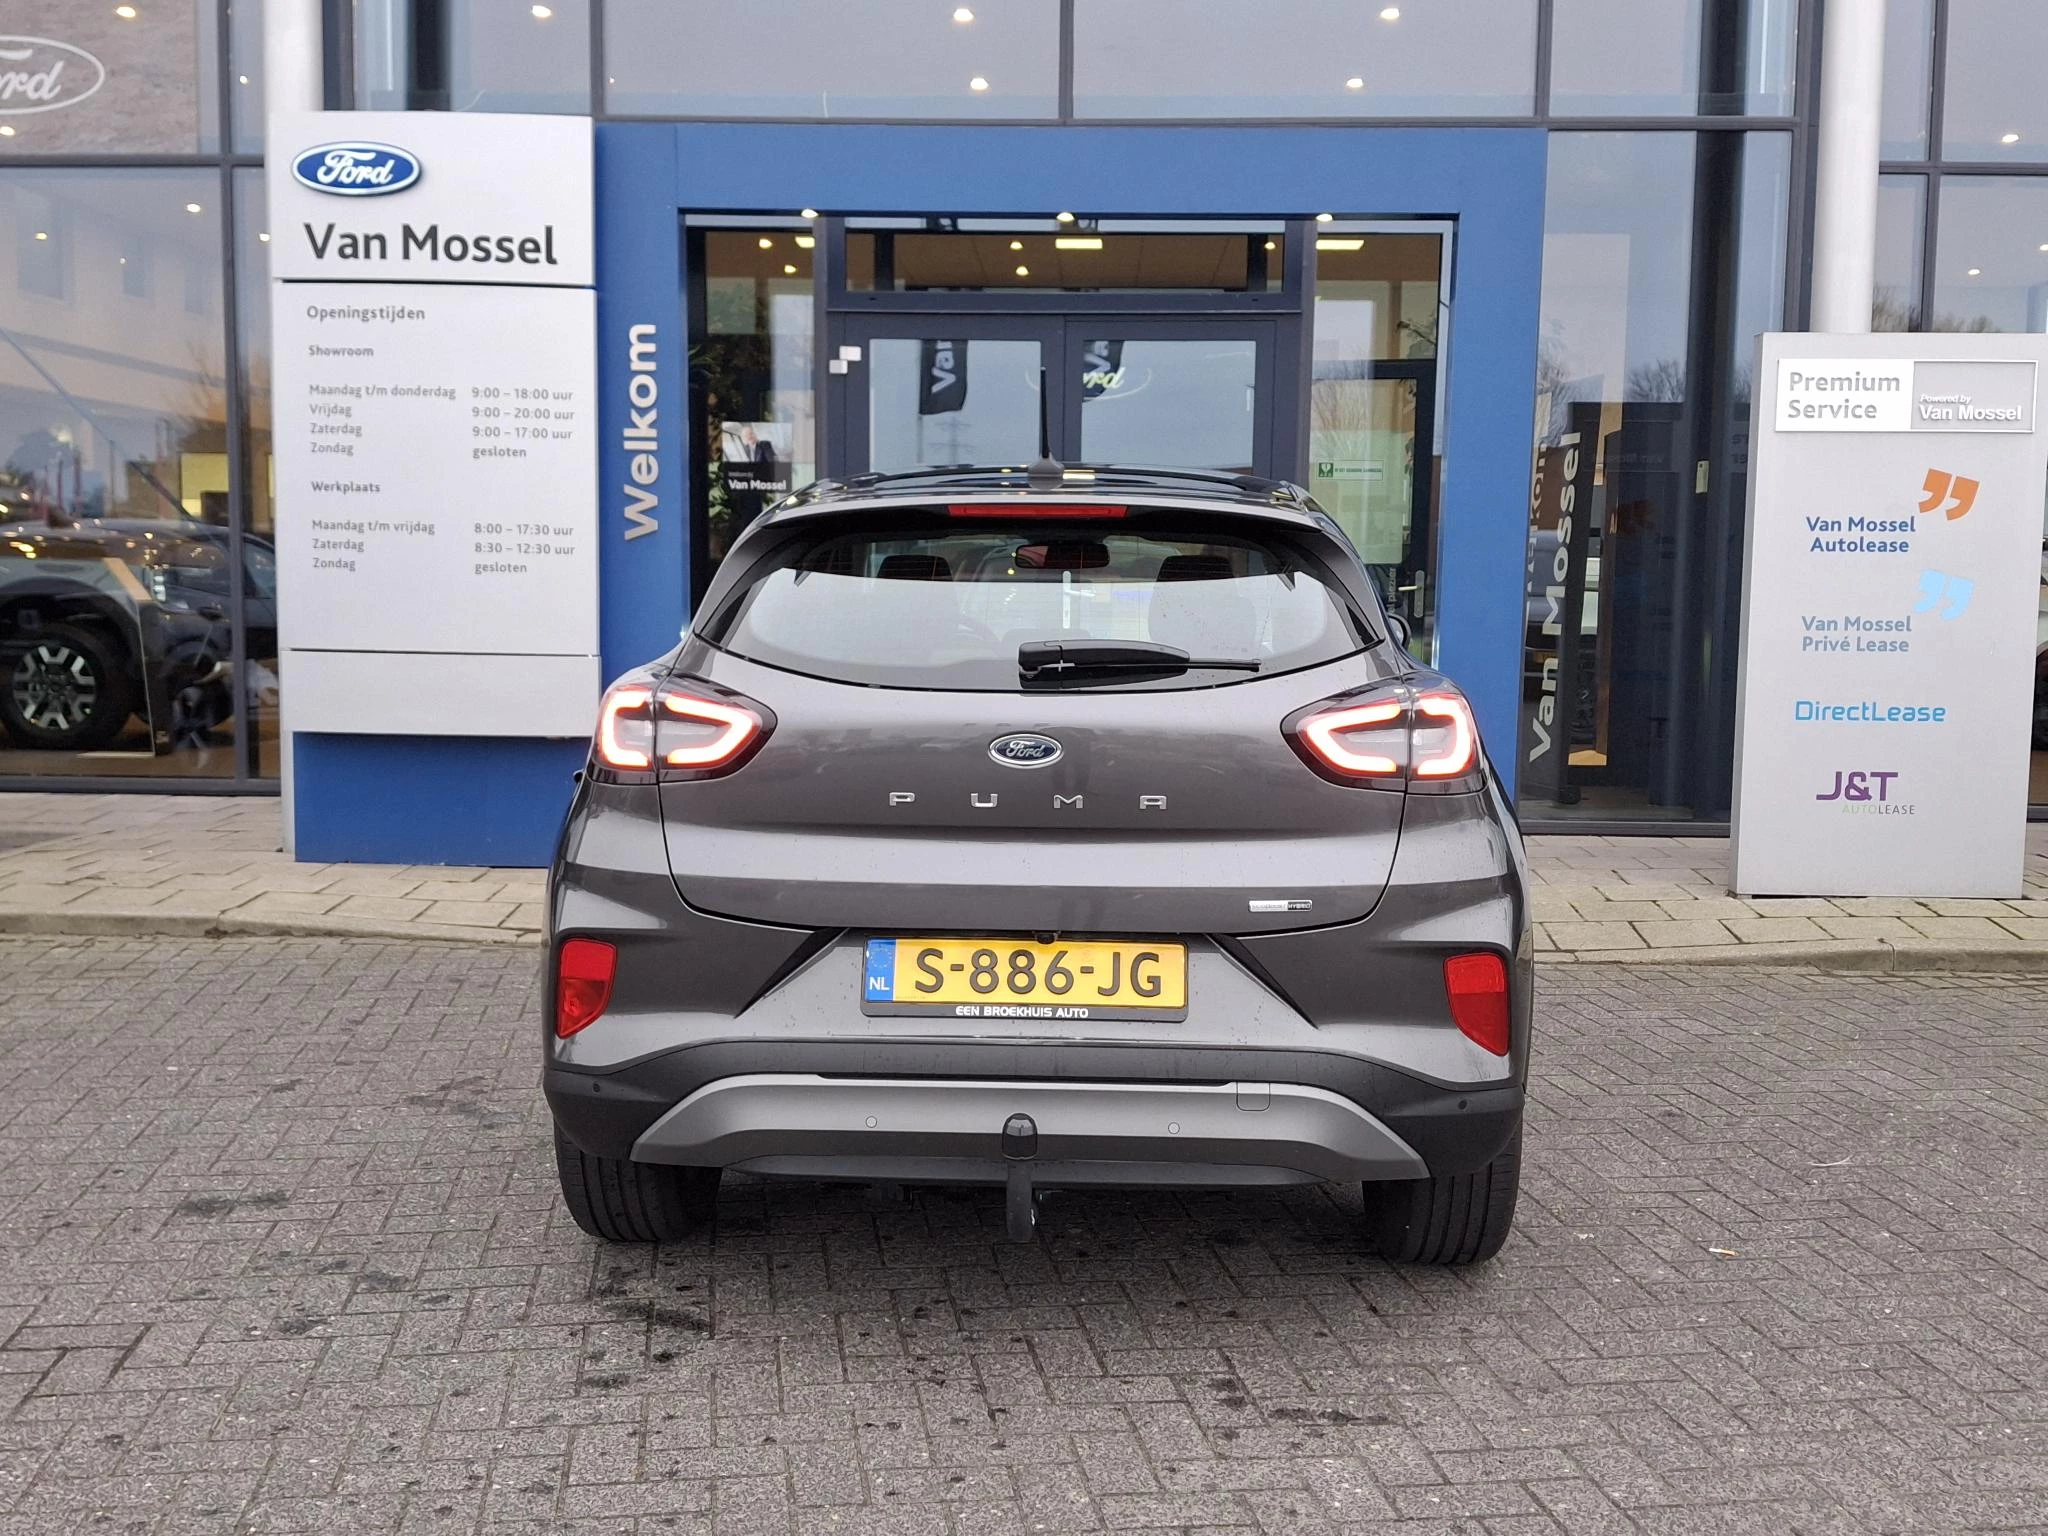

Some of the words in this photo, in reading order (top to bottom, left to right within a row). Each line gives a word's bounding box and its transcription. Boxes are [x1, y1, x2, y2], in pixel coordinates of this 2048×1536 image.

[316, 147, 395, 189] Ford
[304, 222, 387, 261] Van
[402, 224, 558, 265] Mossel
[307, 305, 425, 323] Openingstijden
[309, 345, 374, 357] Showroom
[1789, 371, 1900, 392] Premium
[310, 385, 362, 398] Maandag
[365, 385, 388, 397] t/m
[391, 385, 456, 399] donderdag
[472, 387, 500, 399] 9:00
[514, 388, 549, 400] 18:00
[552, 391, 573, 400] uur
[1919, 394, 1959, 404] Powered
[1960, 395, 1972, 405] by
[310, 404, 352, 418] Vrijdag
[472, 407, 500, 418] 9:00
[514, 408, 550, 419] 20:00
[554, 410, 575, 420] uur
[1787, 399, 1878, 420] Service
[1919, 405, 1953, 421] Van
[1958, 404, 2022, 421] Mossel
[310, 423, 362, 437] Zaterdag
[472, 426, 500, 438] 9:00
[515, 427, 548, 439] 17:00
[552, 430, 572, 439] uur
[623, 324, 659, 541] Welkom
[311, 442, 353, 456] Zondag
[472, 446, 526, 459] gesloten
[312, 482, 380, 494] Werkplaats
[728, 480, 748, 490] Van
[750, 480, 787, 490] Mossel
[312, 520, 364, 533] Maandag
[368, 521, 390, 532] t/m
[394, 521, 435, 535] vrijdag
[475, 523, 502, 535] 8:00
[517, 524, 549, 536] 17:30
[553, 527, 574, 536] uur
[1807, 517, 1842, 532] Van
[1848, 516, 1916, 532] Mossel
[1542, 432, 1581, 636] Mossel
[313, 539, 364, 552] Zaterdag
[475, 542, 503, 554] 8:30
[517, 543, 551, 555] 12:30
[555, 546, 575, 555] uur
[1810, 537, 1909, 552] Autolease
[313, 558, 356, 571] Zondag
[475, 562, 527, 575] gesloten
[1802, 616, 1837, 631] Van
[1844, 616, 1912, 632] Mossel
[1802, 636, 1851, 652] Privé
[1857, 636, 1909, 652] Lease
[1529, 657, 1559, 762] Van
[1795, 701, 1946, 722] DirectLease
[1005, 739, 1045, 759] Ford
[1816, 771, 1898, 802] J&T
[888, 790, 1168, 811] PUMA
[1842, 804, 1915, 815] AUTOLEASE
[914, 947, 1162, 998] S-886-JG
[869, 977, 890, 991] NL
[955, 1005, 980, 1016] EEN
[983, 1005, 1053, 1018] BROEKHUIS
[1055, 1007, 1089, 1019] AUTO
